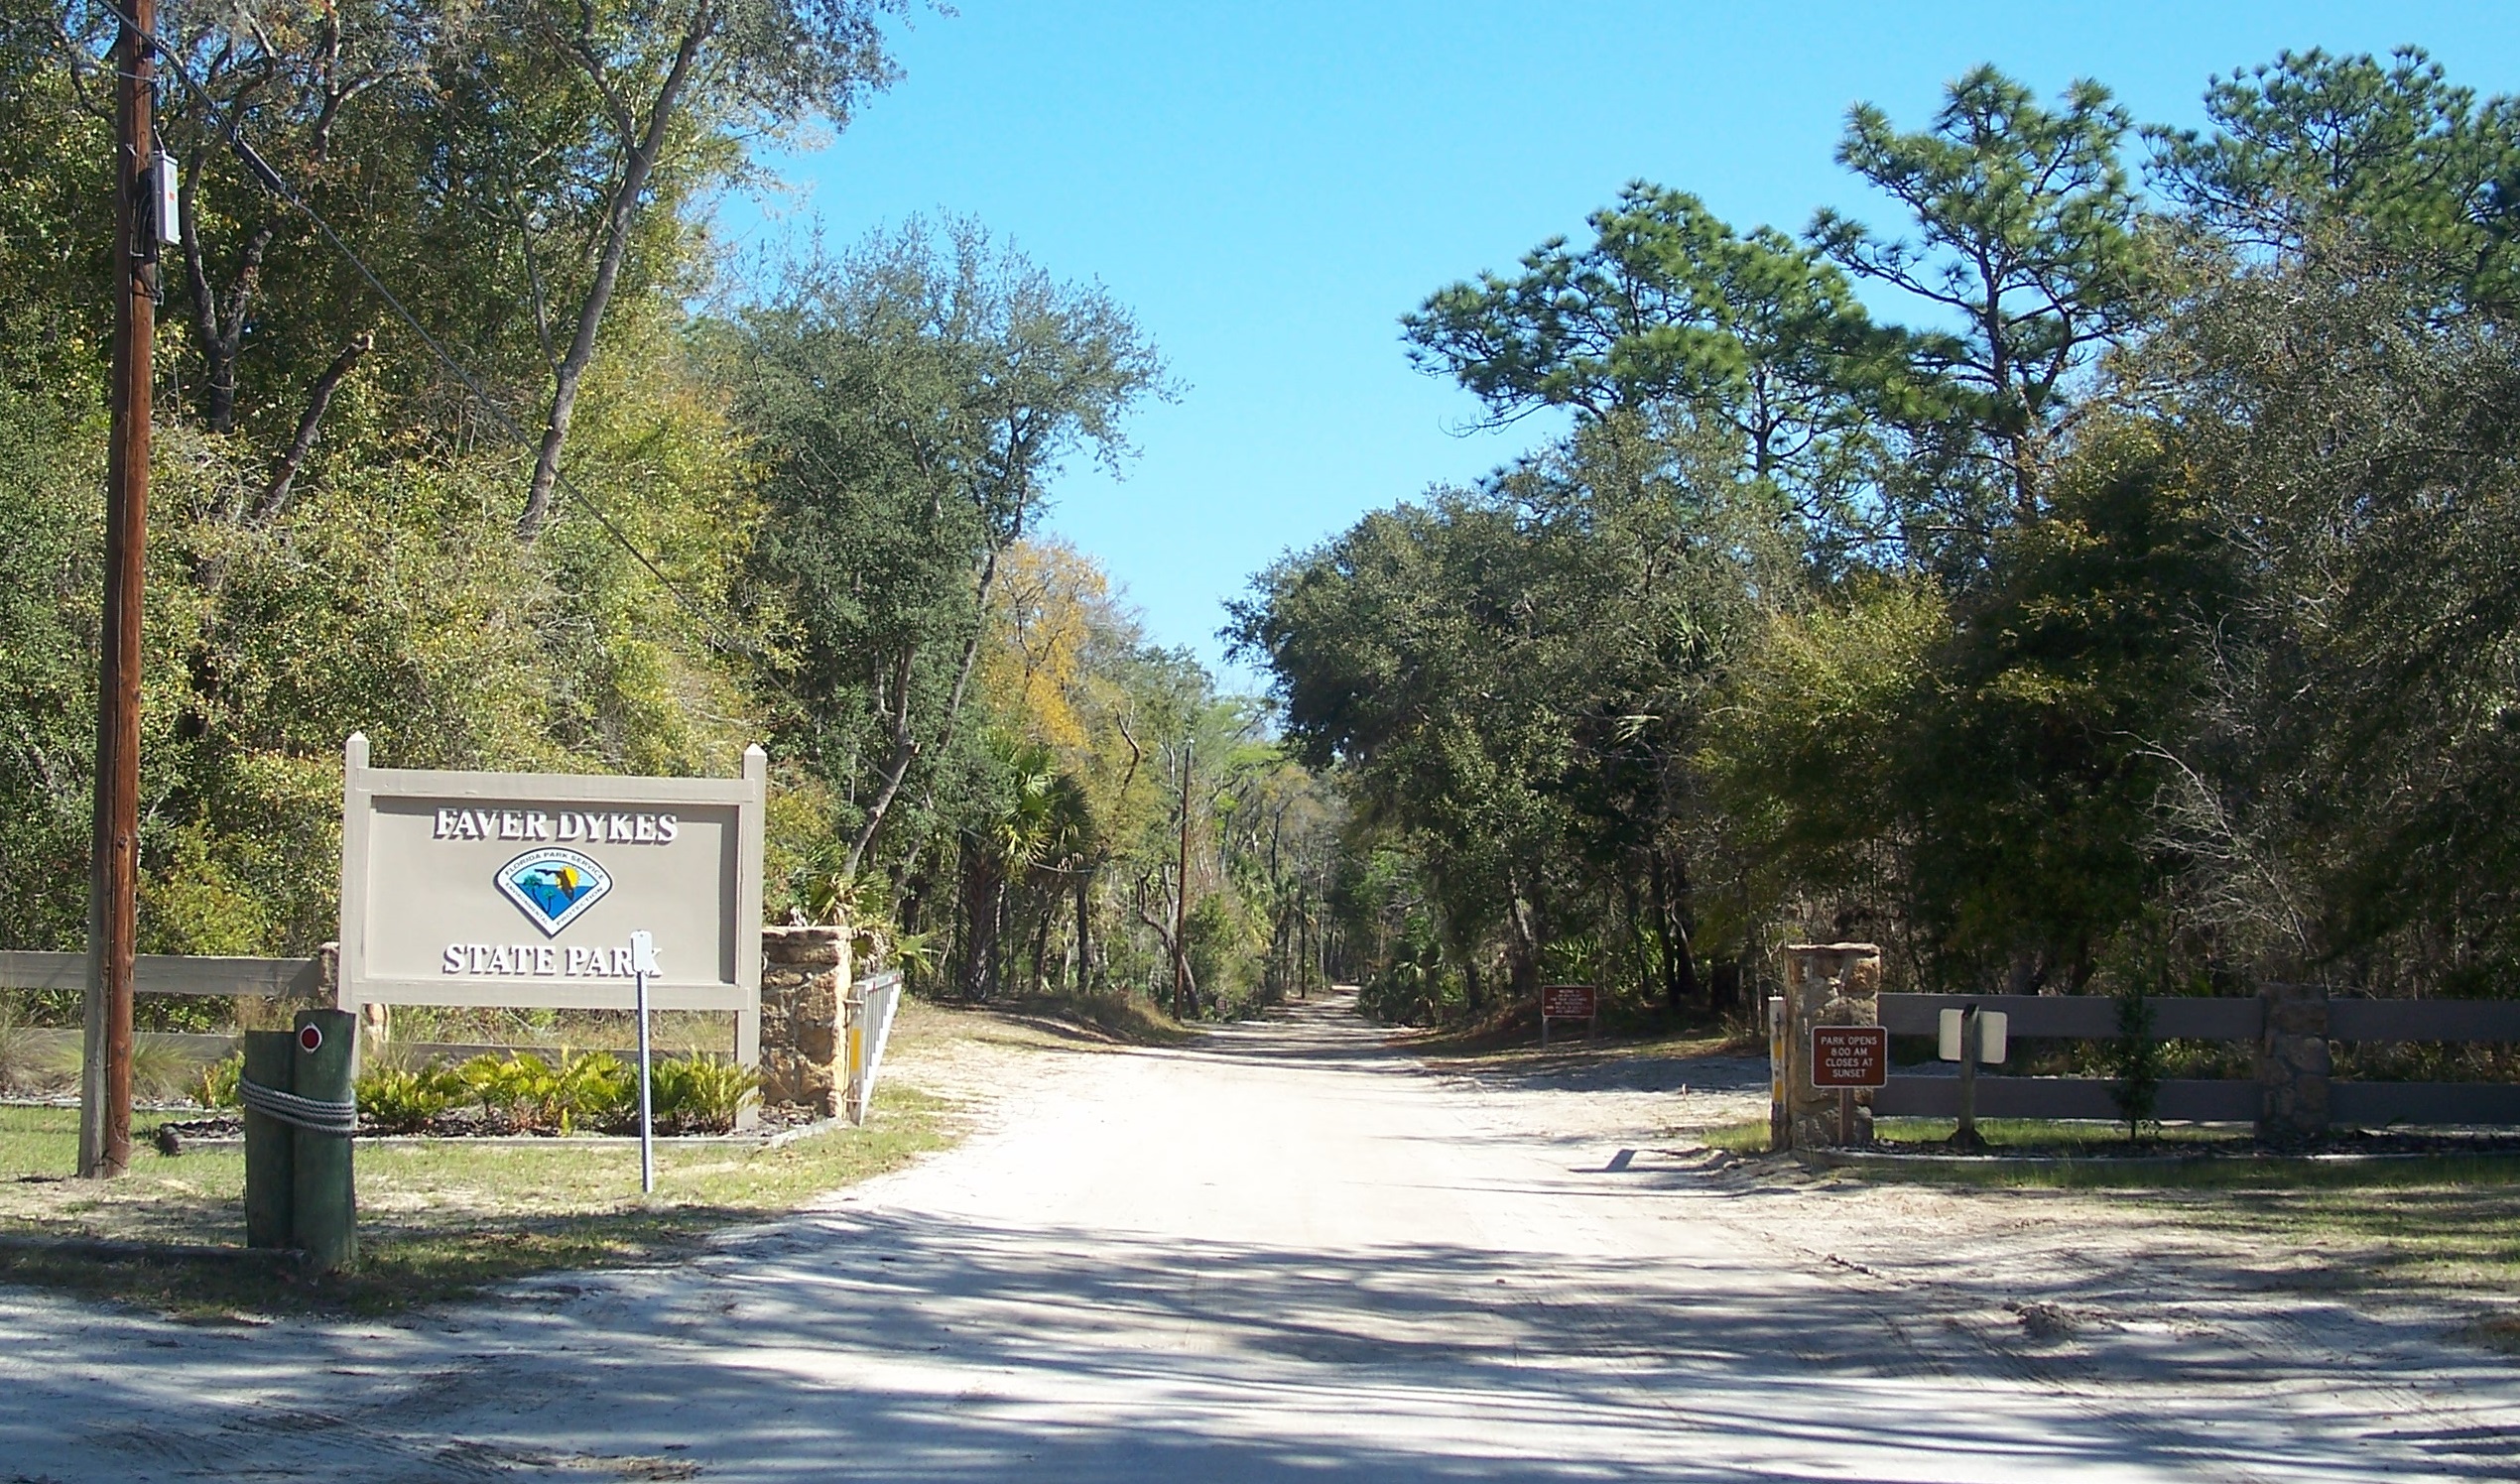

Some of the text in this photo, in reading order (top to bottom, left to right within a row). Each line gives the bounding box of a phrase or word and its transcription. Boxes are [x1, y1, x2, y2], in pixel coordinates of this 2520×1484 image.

[434, 807, 679, 845] FAVER DYKES
[504, 853, 542, 876] FLORIDA
[570, 855, 604, 880] SERVICE
[505, 882, 549, 926] ENVIRONMENTAL
[556, 886, 603, 926] PROTECTION
[442, 943, 557, 976] STATE
[1826, 1057, 1873, 1067] CLOSES AT
[1832, 1068, 1866, 1078] SUNSET
